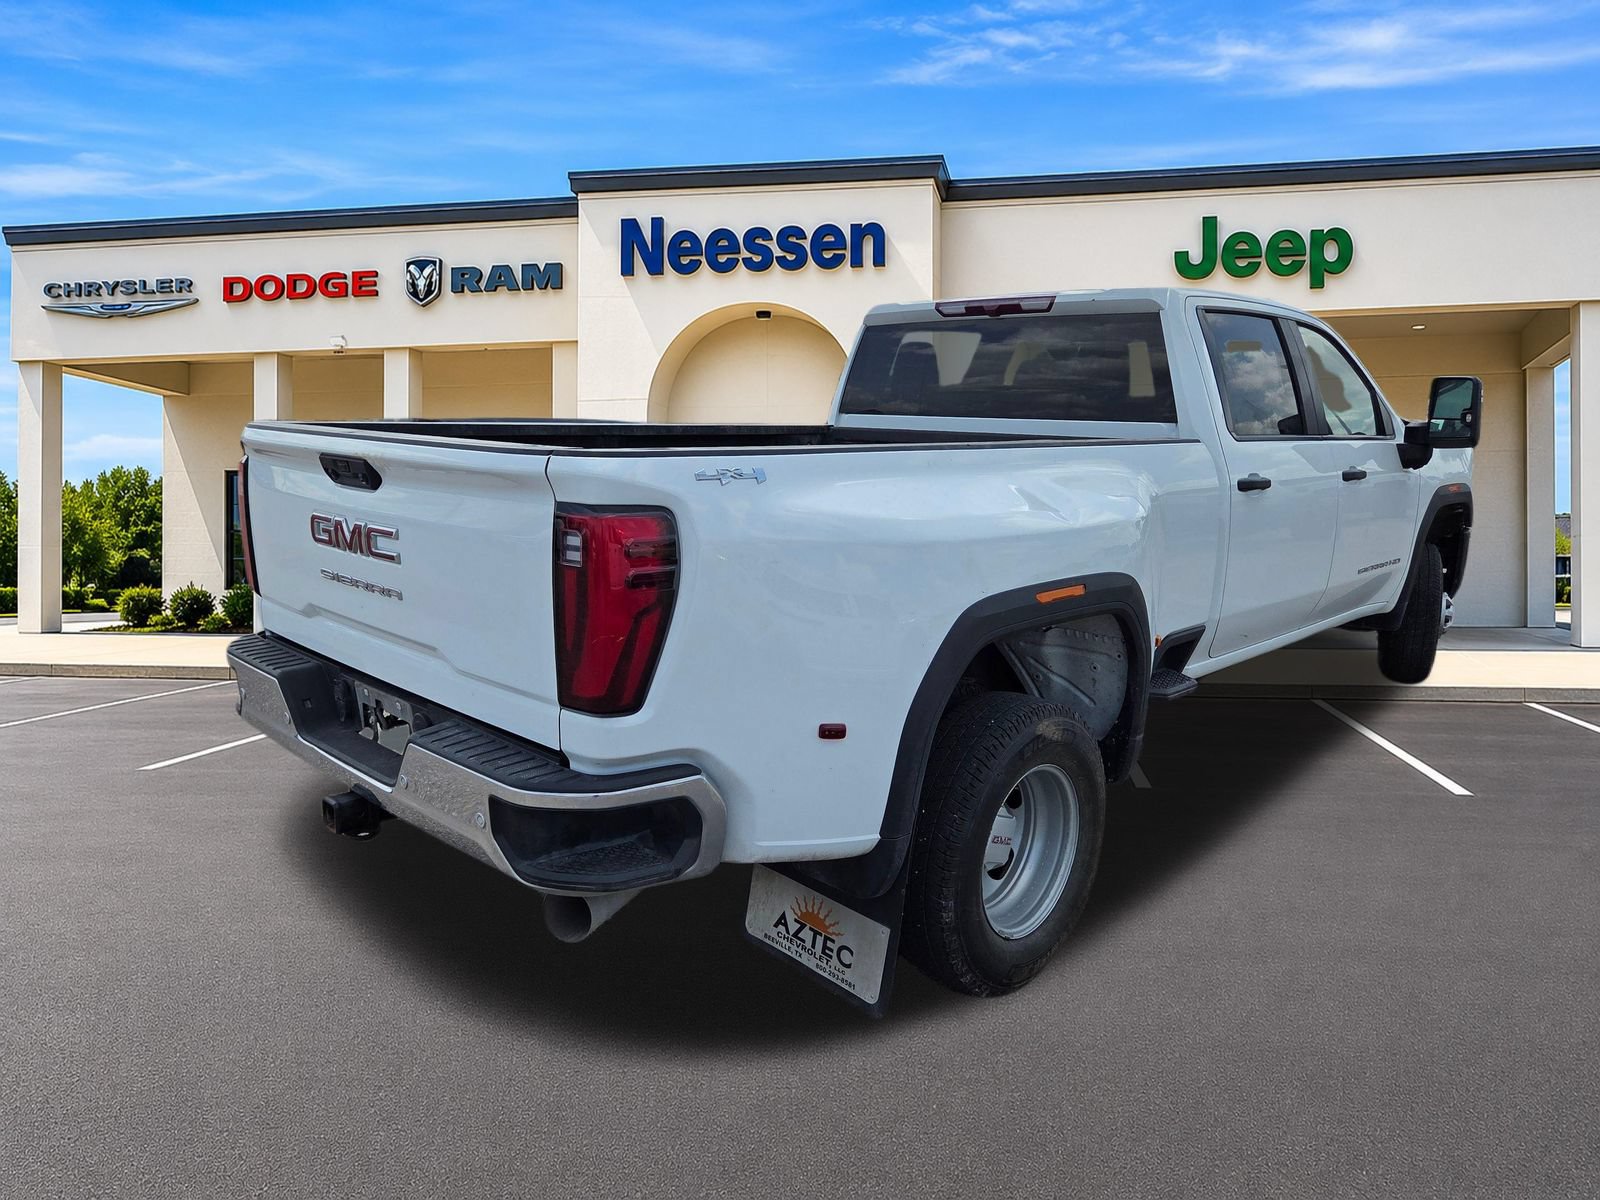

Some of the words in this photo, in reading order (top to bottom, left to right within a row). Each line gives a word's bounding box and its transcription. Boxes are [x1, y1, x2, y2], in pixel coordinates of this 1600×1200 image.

[620, 216, 886, 276] Neessen
[1174, 215, 1354, 289] Jeep
[43, 277, 193, 299] CHRYSLER
[222, 270, 379, 303] DODGE
[450, 262, 563, 294] RAM
[310, 512, 402, 565] GMC
[320, 568, 403, 601] SIERRA
[992, 835, 1012, 846] GMC
[773, 911, 854, 969] AZTEC
[776, 931, 832, 968] CHEVROLET,
[834, 965, 846, 976] LLC
[794, 949, 803, 959] TX
